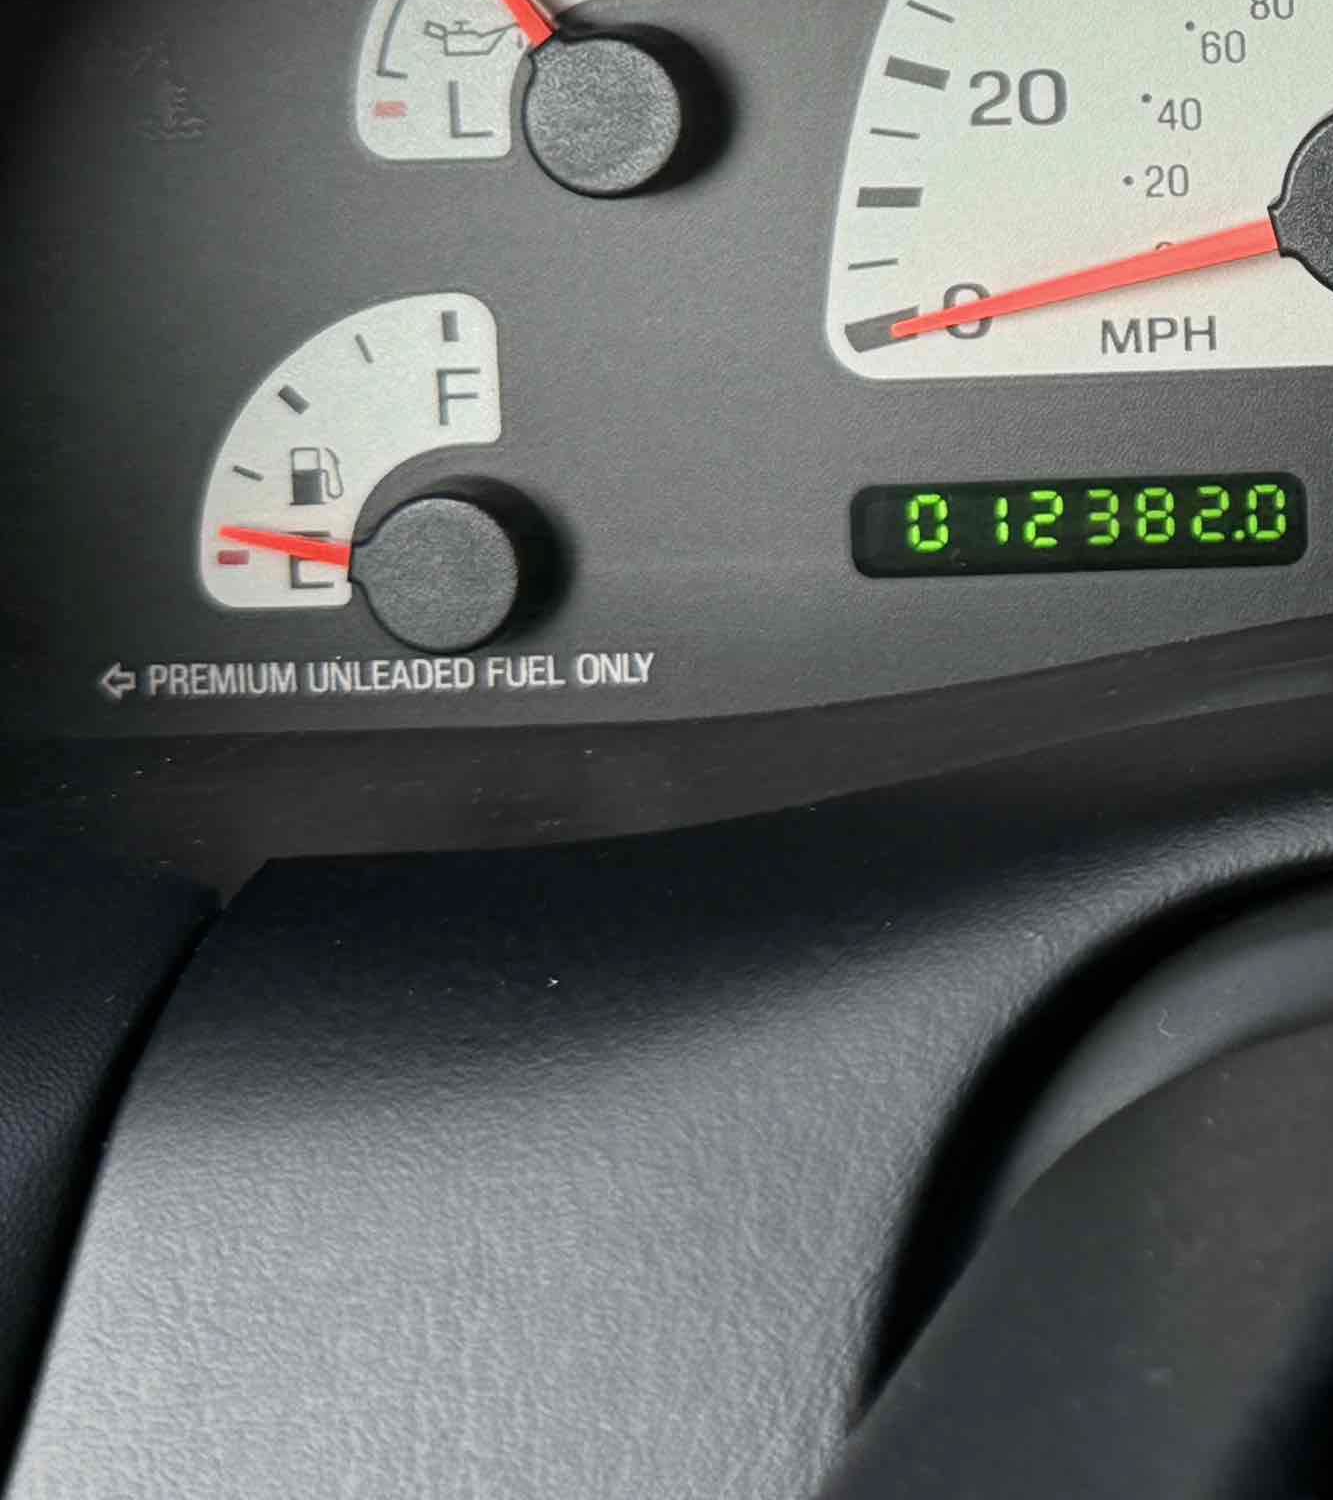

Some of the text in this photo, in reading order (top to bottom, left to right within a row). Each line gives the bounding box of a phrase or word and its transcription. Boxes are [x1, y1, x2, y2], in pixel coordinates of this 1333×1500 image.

[1200, 31, 1245, 64] 60
[448, 81, 493, 139] L
[970, 69, 1066, 126] 20
[1158, 98, 1201, 131] 40
[1145, 164, 1188, 197] 20
[943, 283, 993, 339] 0
[1102, 316, 1216, 354] MPH
[436, 368, 480, 426] F
[150, 653, 653, 694] PREMIUM UNLEADED FUEL ONLY
